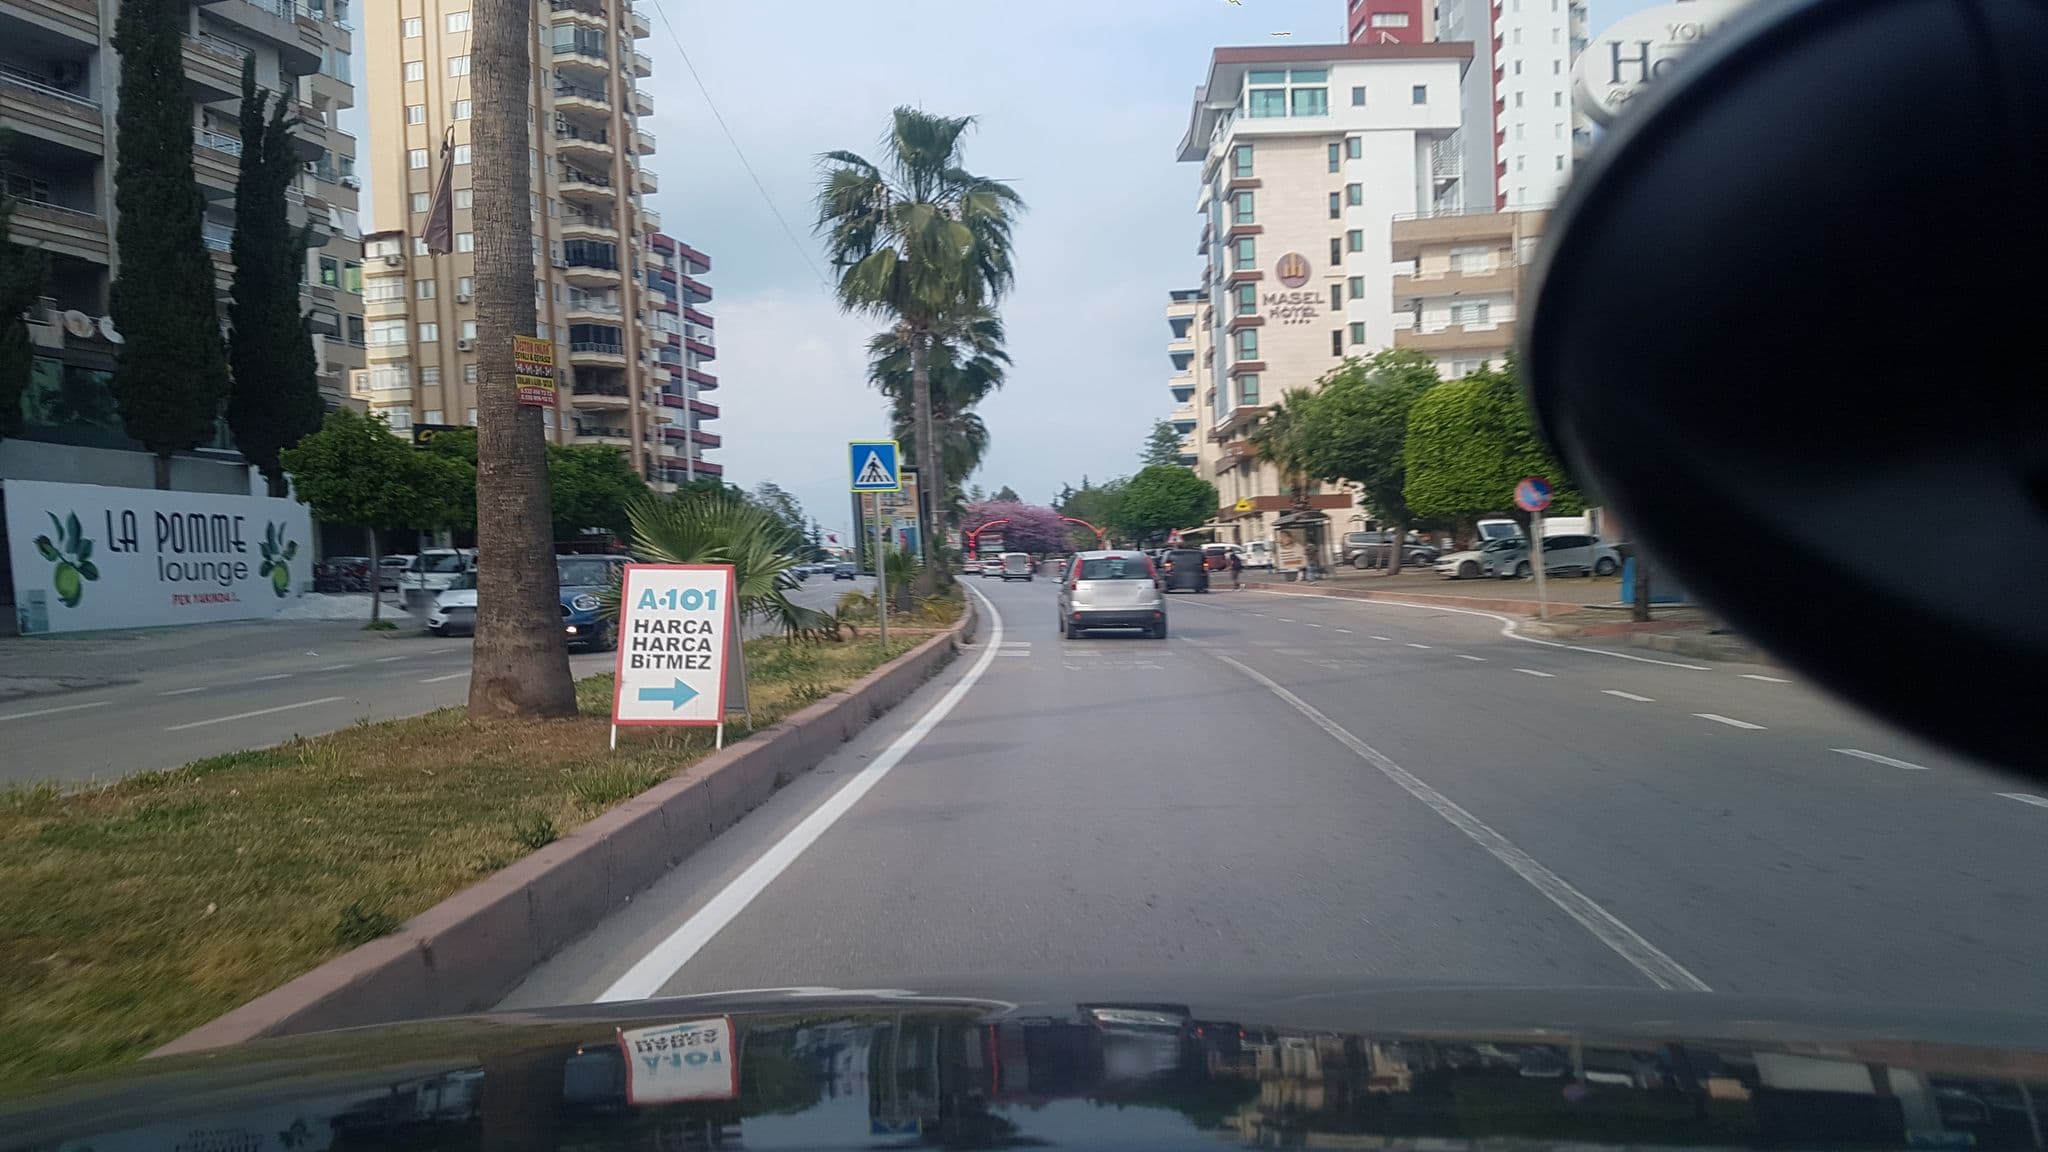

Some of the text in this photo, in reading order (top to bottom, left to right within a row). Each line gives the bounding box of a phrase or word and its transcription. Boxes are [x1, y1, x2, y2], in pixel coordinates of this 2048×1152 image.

[1263, 292, 1325, 306] MASEL
[1269, 305, 1320, 319] HOTEL
[105, 509, 248, 554] LA POMME
[157, 555, 249, 587] lounge
[634, 619, 714, 635] HARCA
[632, 637, 712, 653] HARCA
